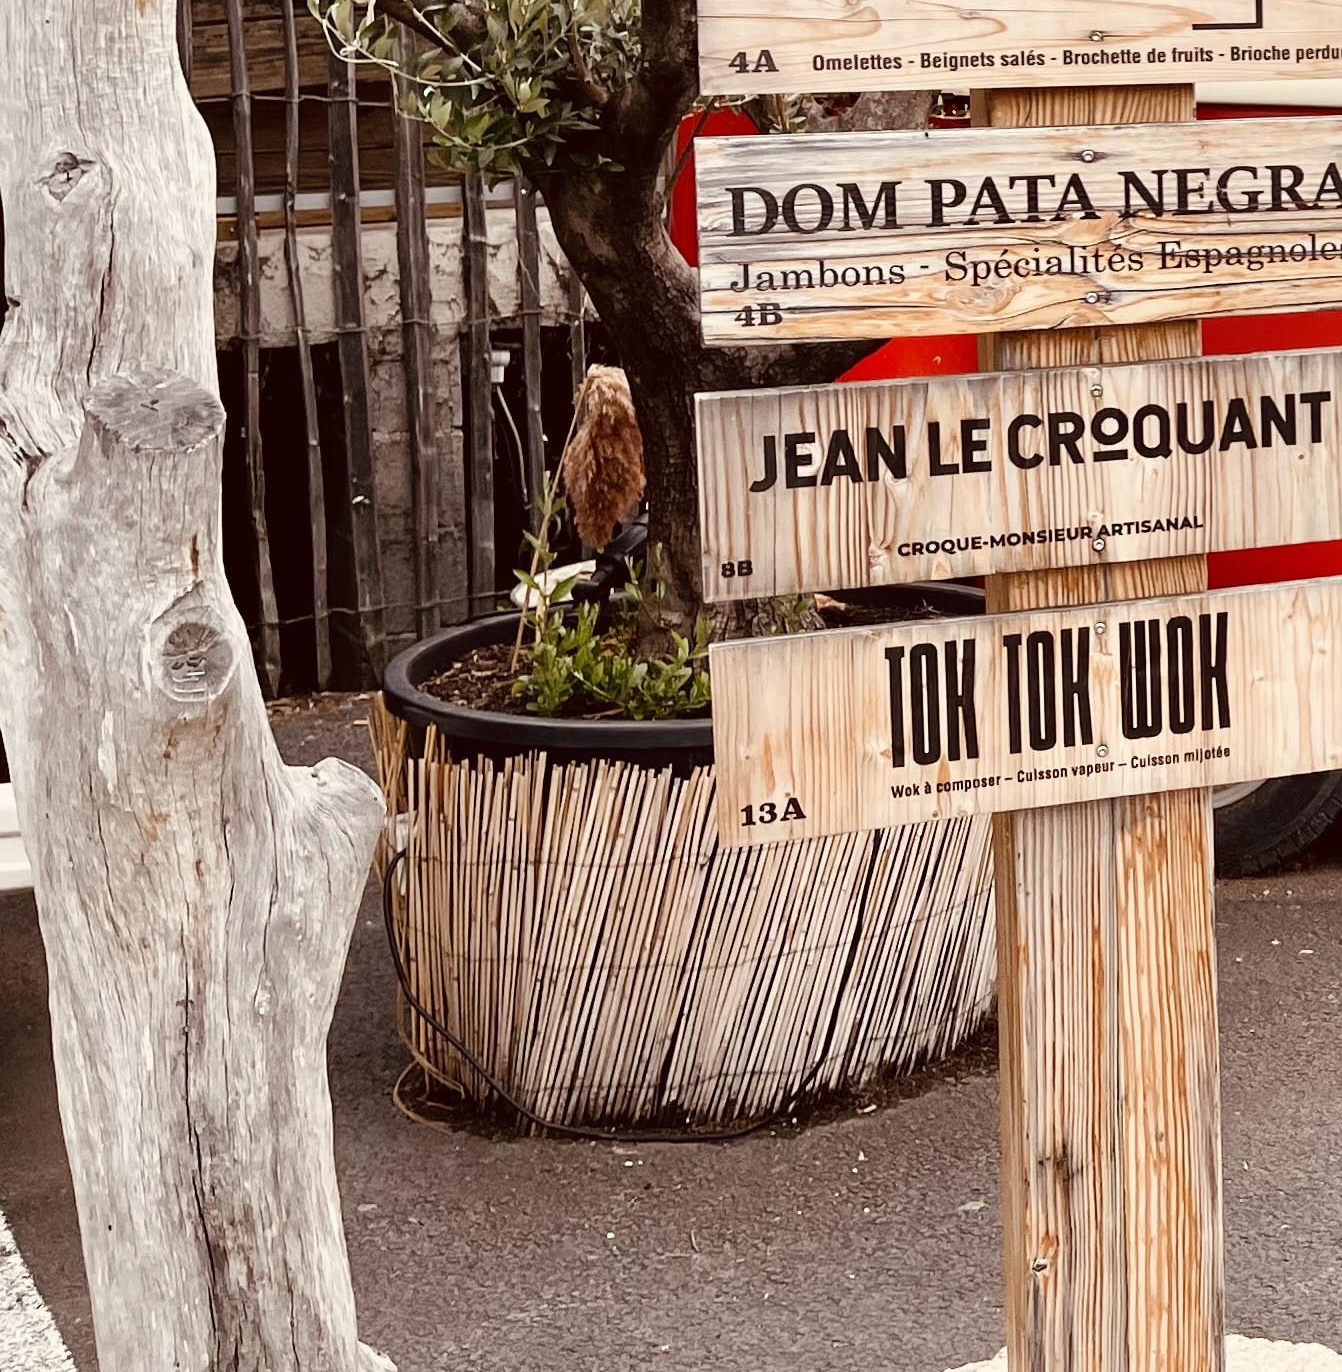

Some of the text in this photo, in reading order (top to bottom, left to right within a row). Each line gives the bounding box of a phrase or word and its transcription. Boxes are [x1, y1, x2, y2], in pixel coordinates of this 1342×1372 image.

[728, 49, 780, 75] 4A
[812, 54, 903, 72] Omelettes
[920, 51, 995, 72] Beignets
[1000, 48, 1046, 68] salés
[1062, 48, 1142, 66] Brochette
[1146, 47, 1167, 64] de
[1171, 46, 1214, 63] fruits
[1230, 45, 1291, 62] Brioche
[724, 181, 902, 239] DOM
[924, 173, 1101, 229] PATA
[729, 261, 906, 295] Jambons
[944, 241, 1144, 286] Spécialités
[734, 303, 784, 329] 4B
[749, 390, 1332, 494] JEAN LE CROQUANT
[897, 515, 1204, 557] CROQUE-MONSIEUR ARTISANAL
[720, 560, 753, 580] 8B
[884, 612, 1231, 769] TOK TOK WOK
[891, 783, 920, 799] Wok
[924, 780, 932, 795] à
[936, 775, 1001, 794] composer
[1017, 766, 1068, 783] Cuisson
[1071, 761, 1115, 778] vapeur
[1131, 753, 1180, 769] Cuisson
[1184, 746, 1231, 765] mijotée
[740, 796, 807, 827] 13A
